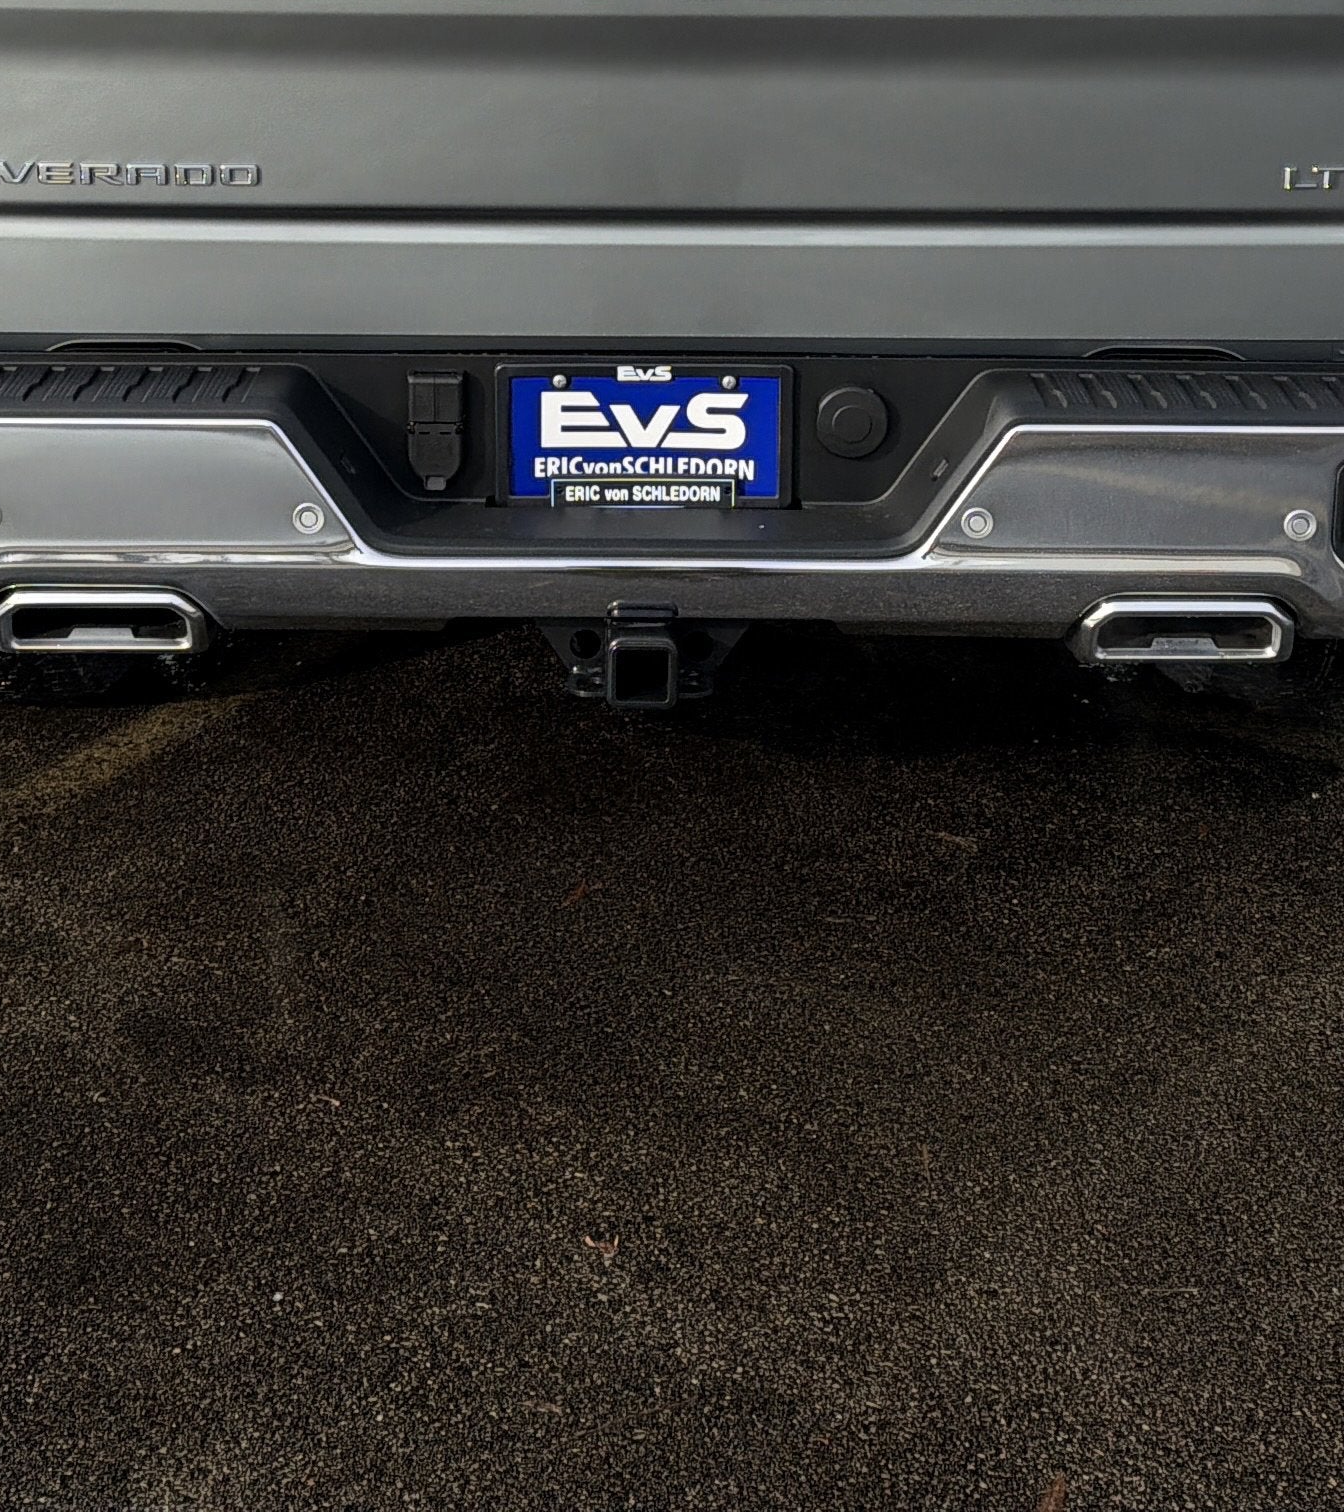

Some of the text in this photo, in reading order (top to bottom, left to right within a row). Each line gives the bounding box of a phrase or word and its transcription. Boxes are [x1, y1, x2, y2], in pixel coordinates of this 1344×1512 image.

[616, 365, 673, 382] EvS
[541, 391, 749, 450] EvS
[565, 484, 721, 503] ERIC von SCHLEDORN
